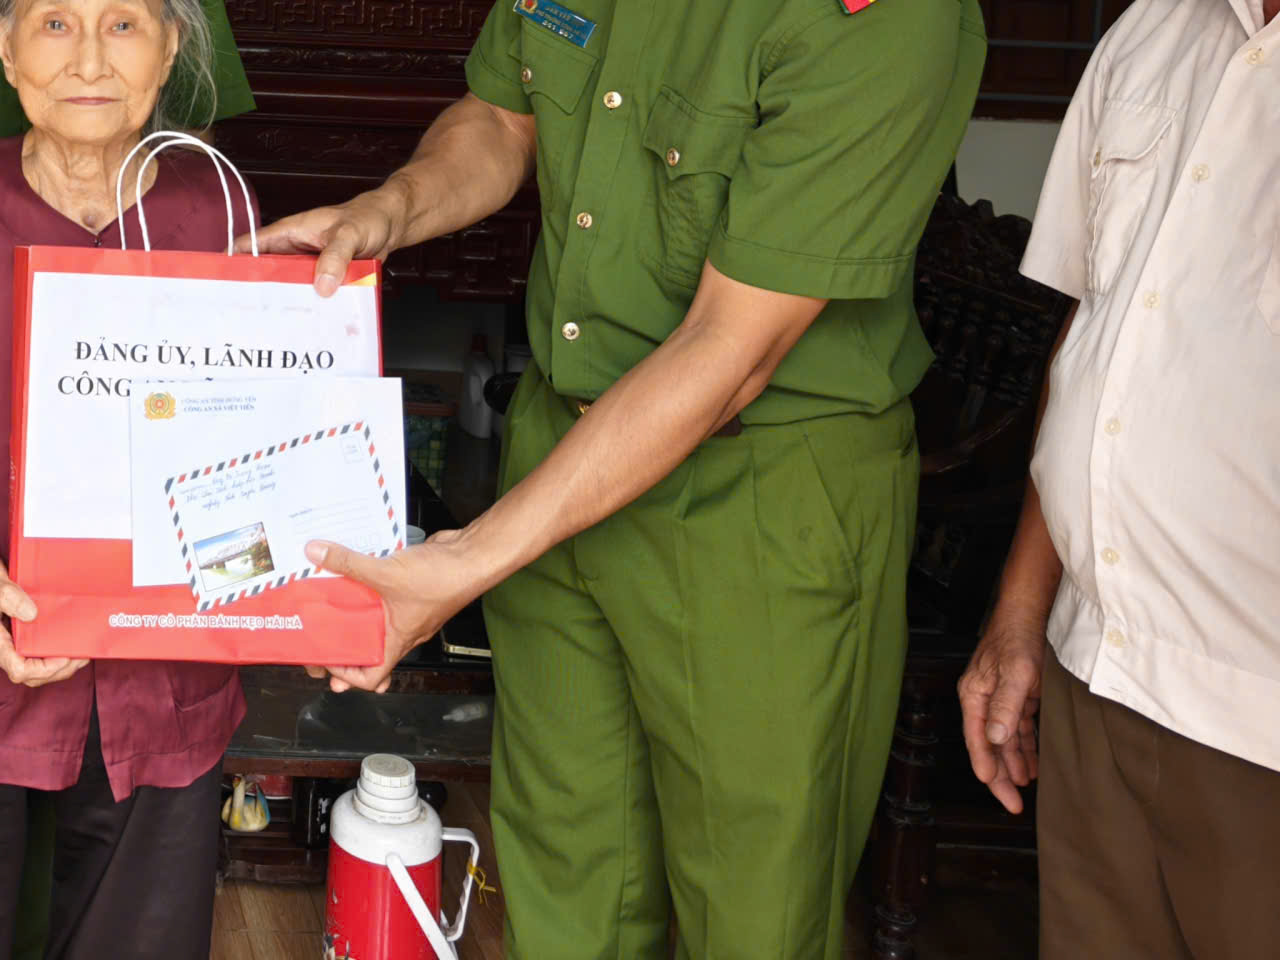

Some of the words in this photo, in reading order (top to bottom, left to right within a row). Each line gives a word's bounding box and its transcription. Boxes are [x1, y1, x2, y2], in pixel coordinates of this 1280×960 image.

[74, 336, 148, 363] ĐẢNG
[157, 339, 196, 368] ỦY,
[203, 343, 273, 369] LÃNH
[280, 349, 335, 375] ĐẠO
[57, 370, 132, 398] CÔNG
[109, 612, 141, 627] CÔNG
[142, 614, 157, 628] TY
[209, 614, 240, 628] BÁNH
[240, 615, 265, 631] KẸO
